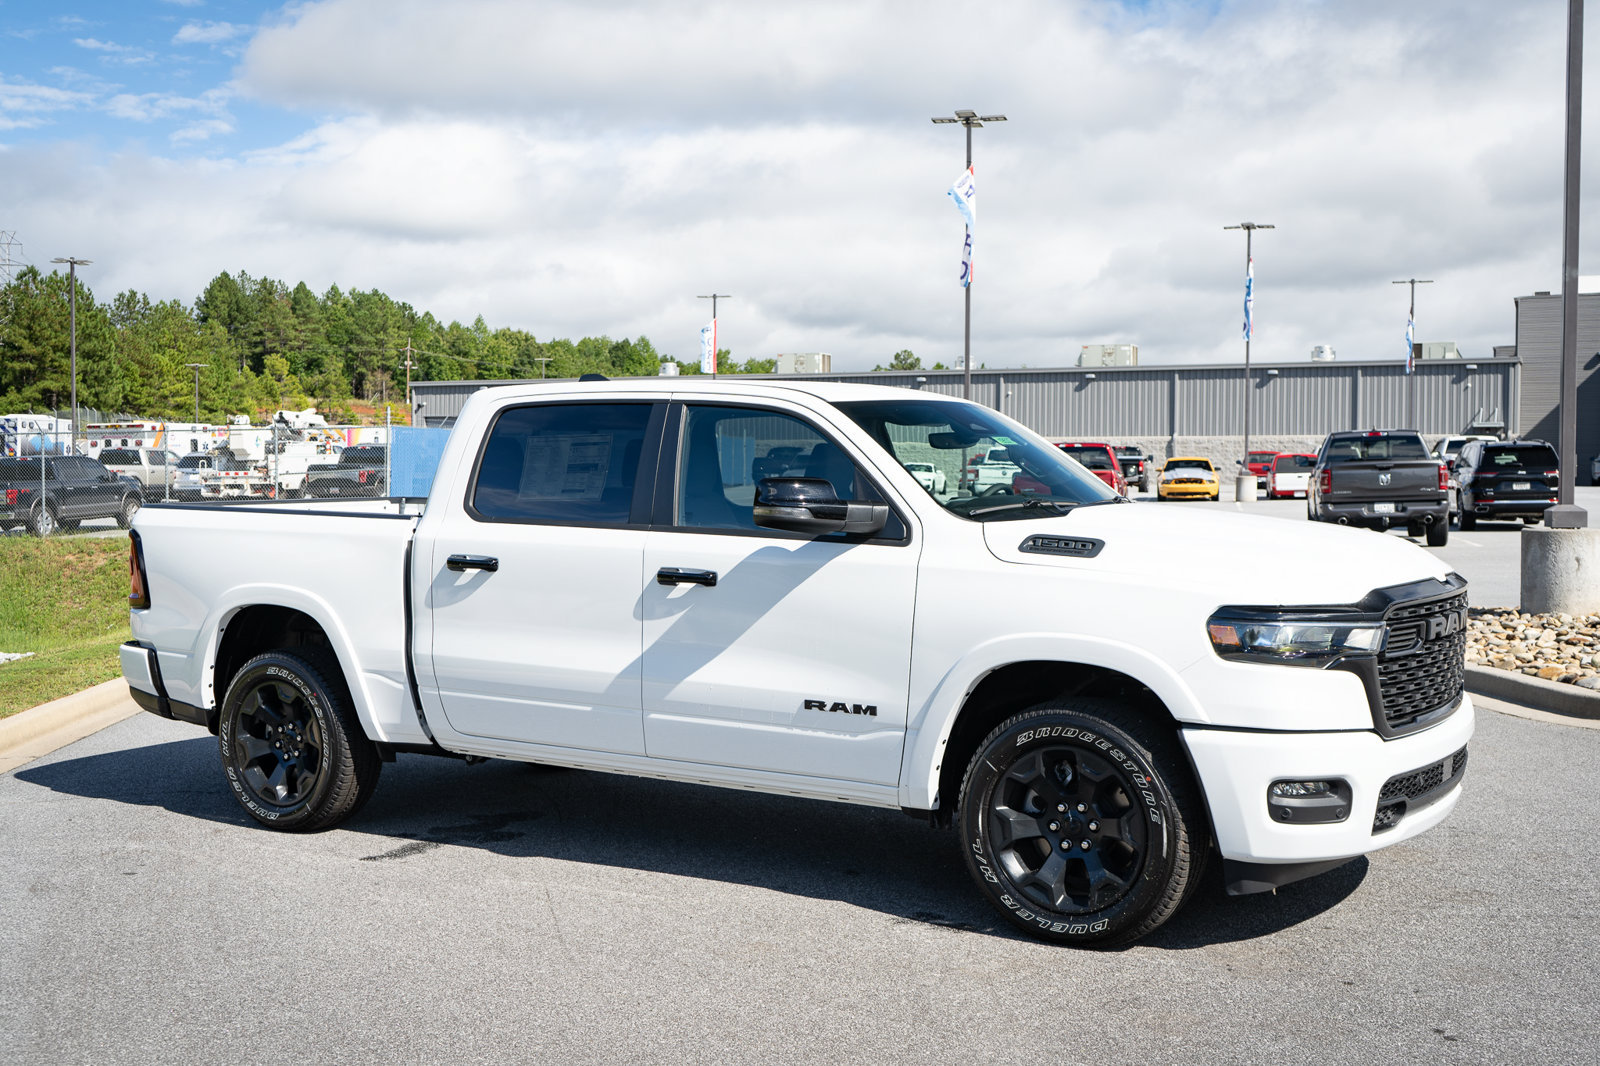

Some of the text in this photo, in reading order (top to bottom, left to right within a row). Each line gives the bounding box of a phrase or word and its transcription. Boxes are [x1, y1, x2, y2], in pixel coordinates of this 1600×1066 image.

[1023, 538, 1093, 550] 1500
[266, 666, 332, 769] BRIDGESTONE
[804, 699, 878, 716] RAM
[227, 766, 280, 821] DUELER
[1015, 726, 1162, 826] BRIDGESTONE
[970, 837, 1109, 935] DUELER H/L
